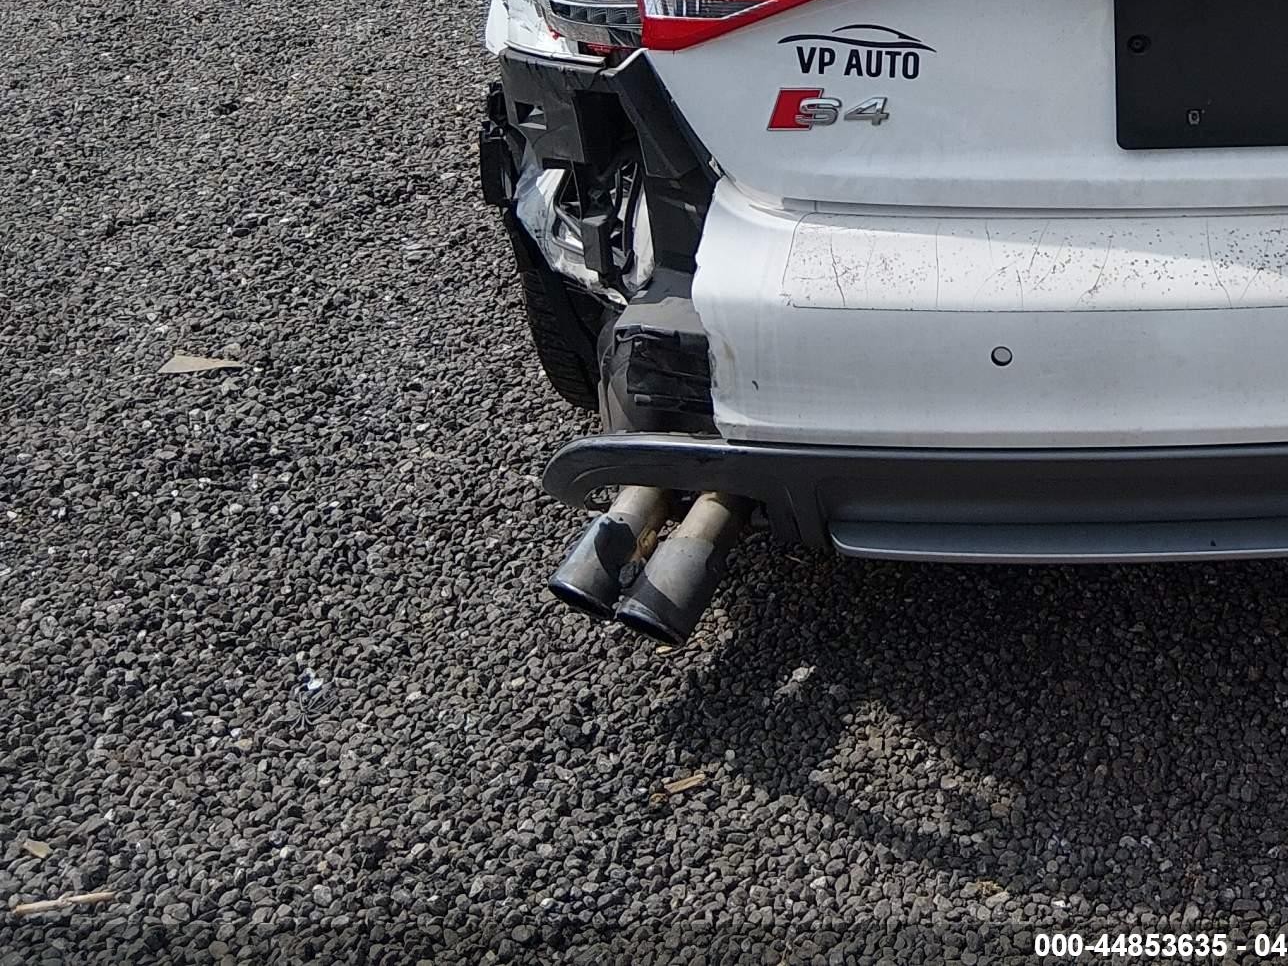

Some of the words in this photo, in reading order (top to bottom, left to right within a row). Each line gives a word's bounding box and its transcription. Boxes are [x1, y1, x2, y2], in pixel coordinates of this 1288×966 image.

[796, 46, 835, 74] VP
[843, 48, 920, 80] AUTO
[795, 96, 890, 127] S4
